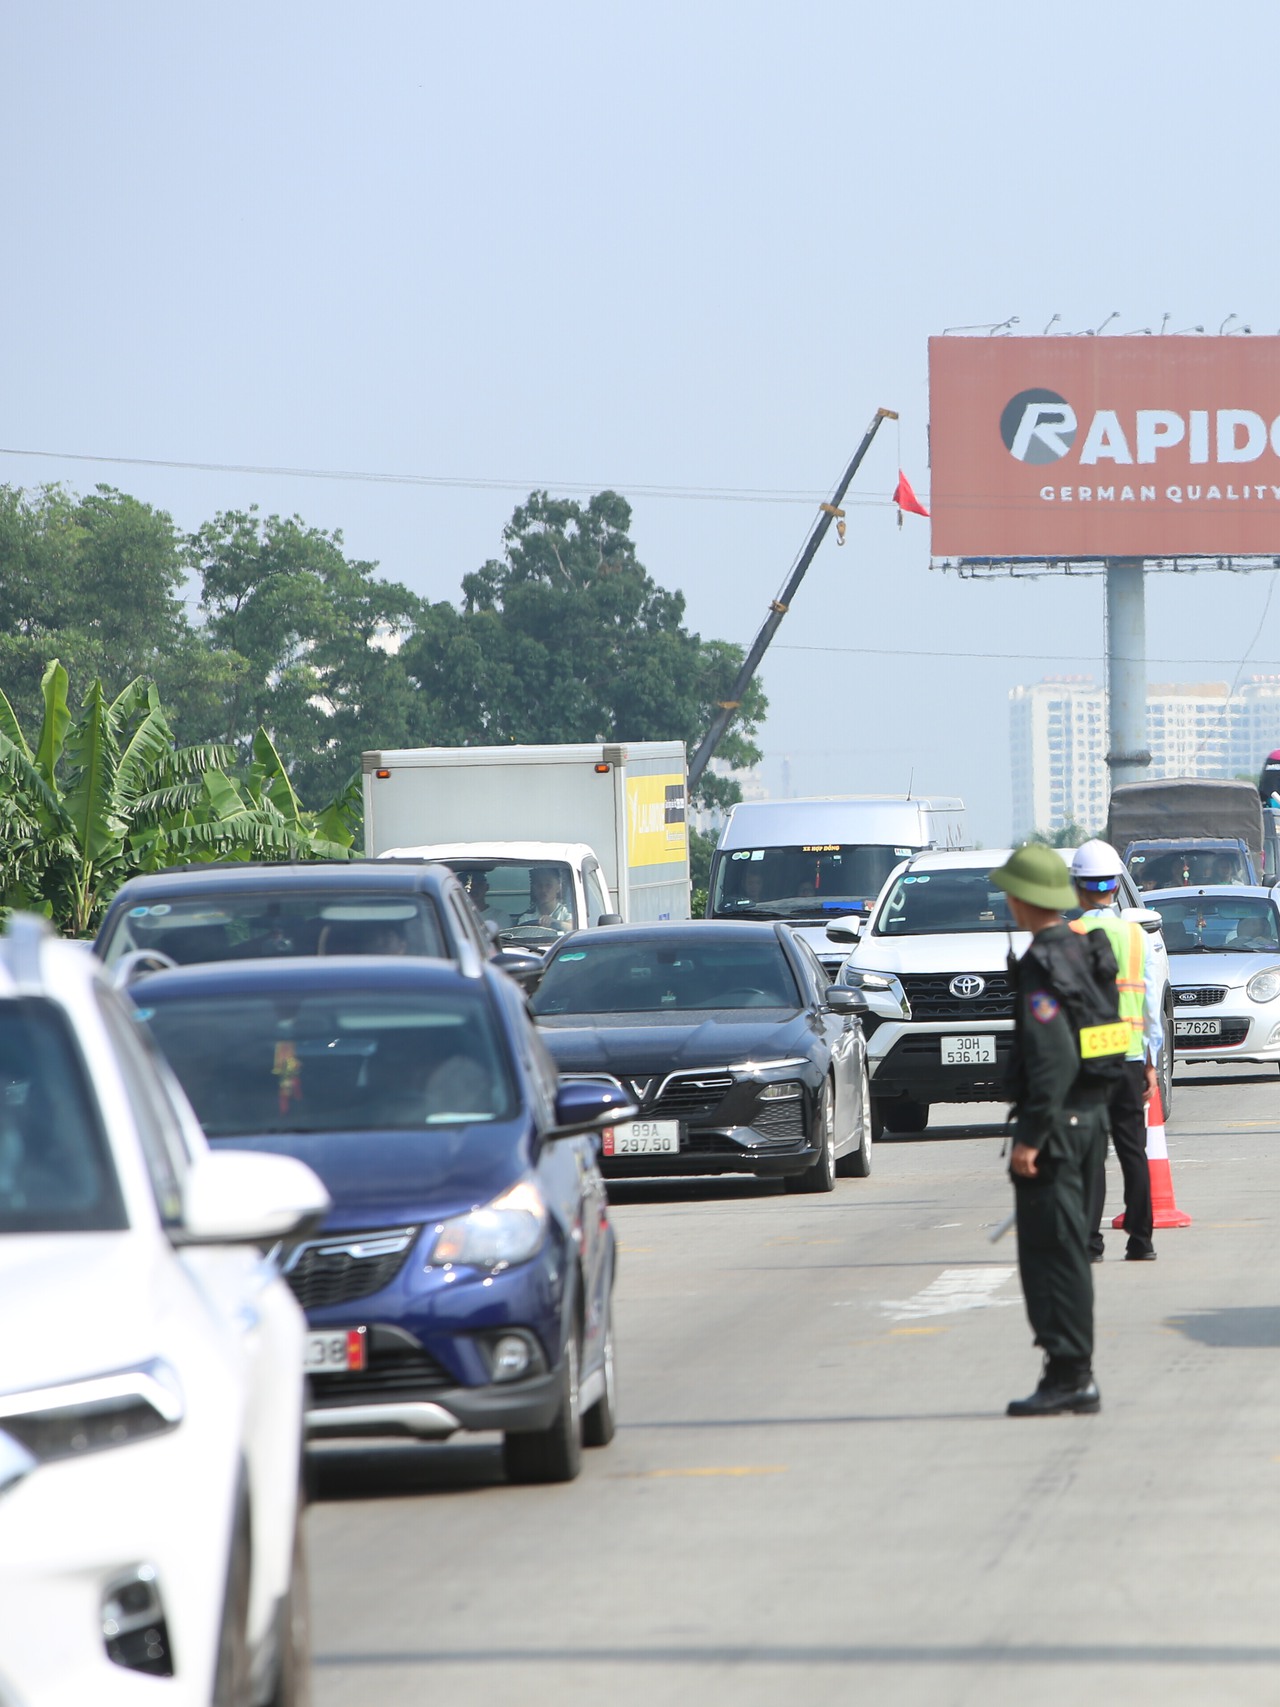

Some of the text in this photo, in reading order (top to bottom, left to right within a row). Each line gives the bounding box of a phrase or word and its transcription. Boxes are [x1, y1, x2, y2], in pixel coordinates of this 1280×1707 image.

[1039, 484, 1157, 502] GERMAN
[1175, 1021, 1217, 1035] F-7626
[956, 1037, 980, 1051] 30H
[947, 1050, 990, 1063] 536.12
[631, 1123, 660, 1138] 89A
[620, 1137, 672, 1154] 297.50
